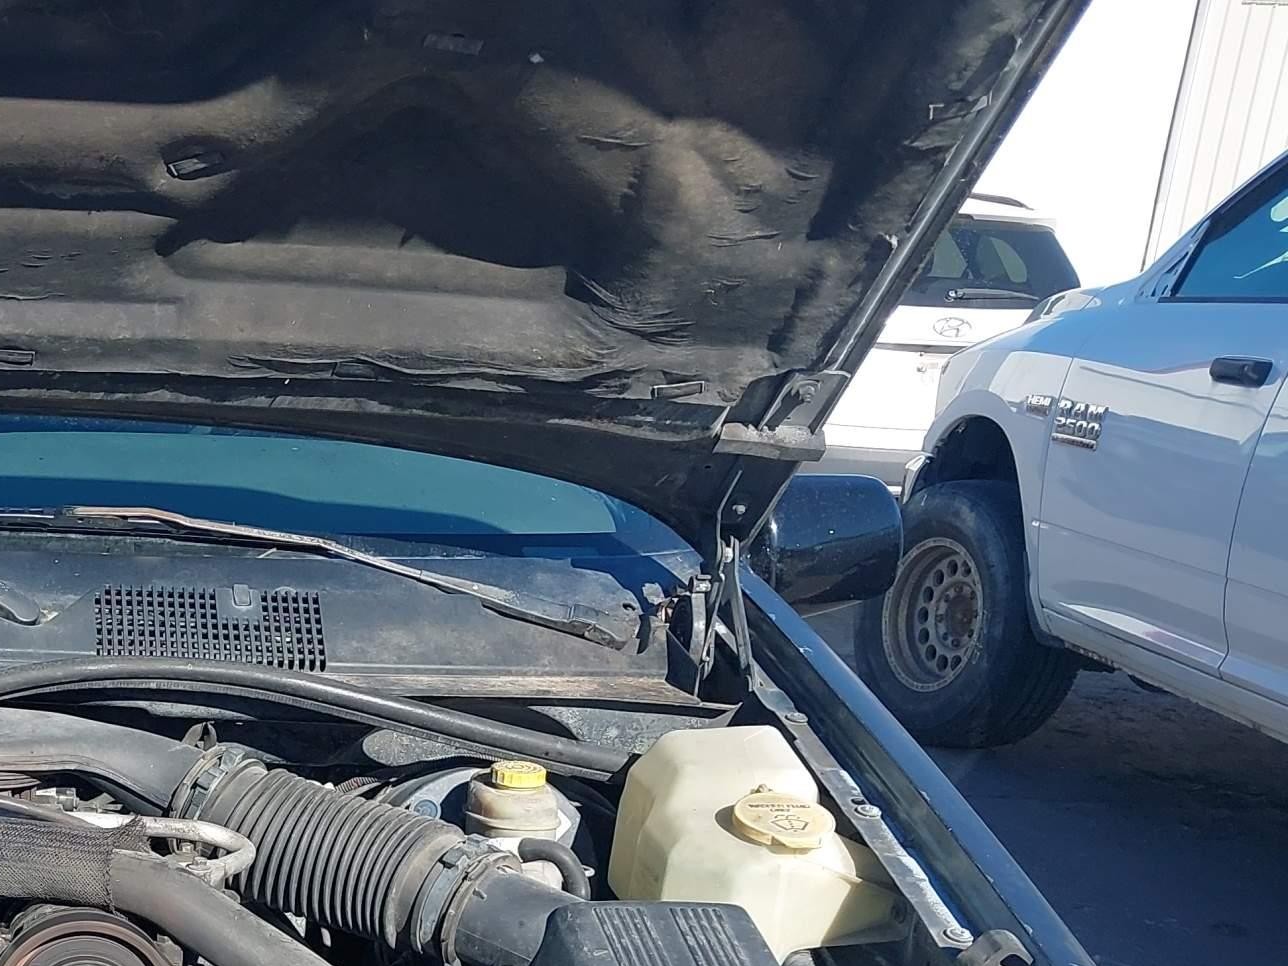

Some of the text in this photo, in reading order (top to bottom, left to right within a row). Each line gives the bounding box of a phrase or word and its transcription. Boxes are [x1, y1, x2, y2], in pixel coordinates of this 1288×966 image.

[1027, 394, 1052, 407] HEMI
[1057, 398, 1109, 422] RAM
[1053, 416, 1102, 440] 2500
